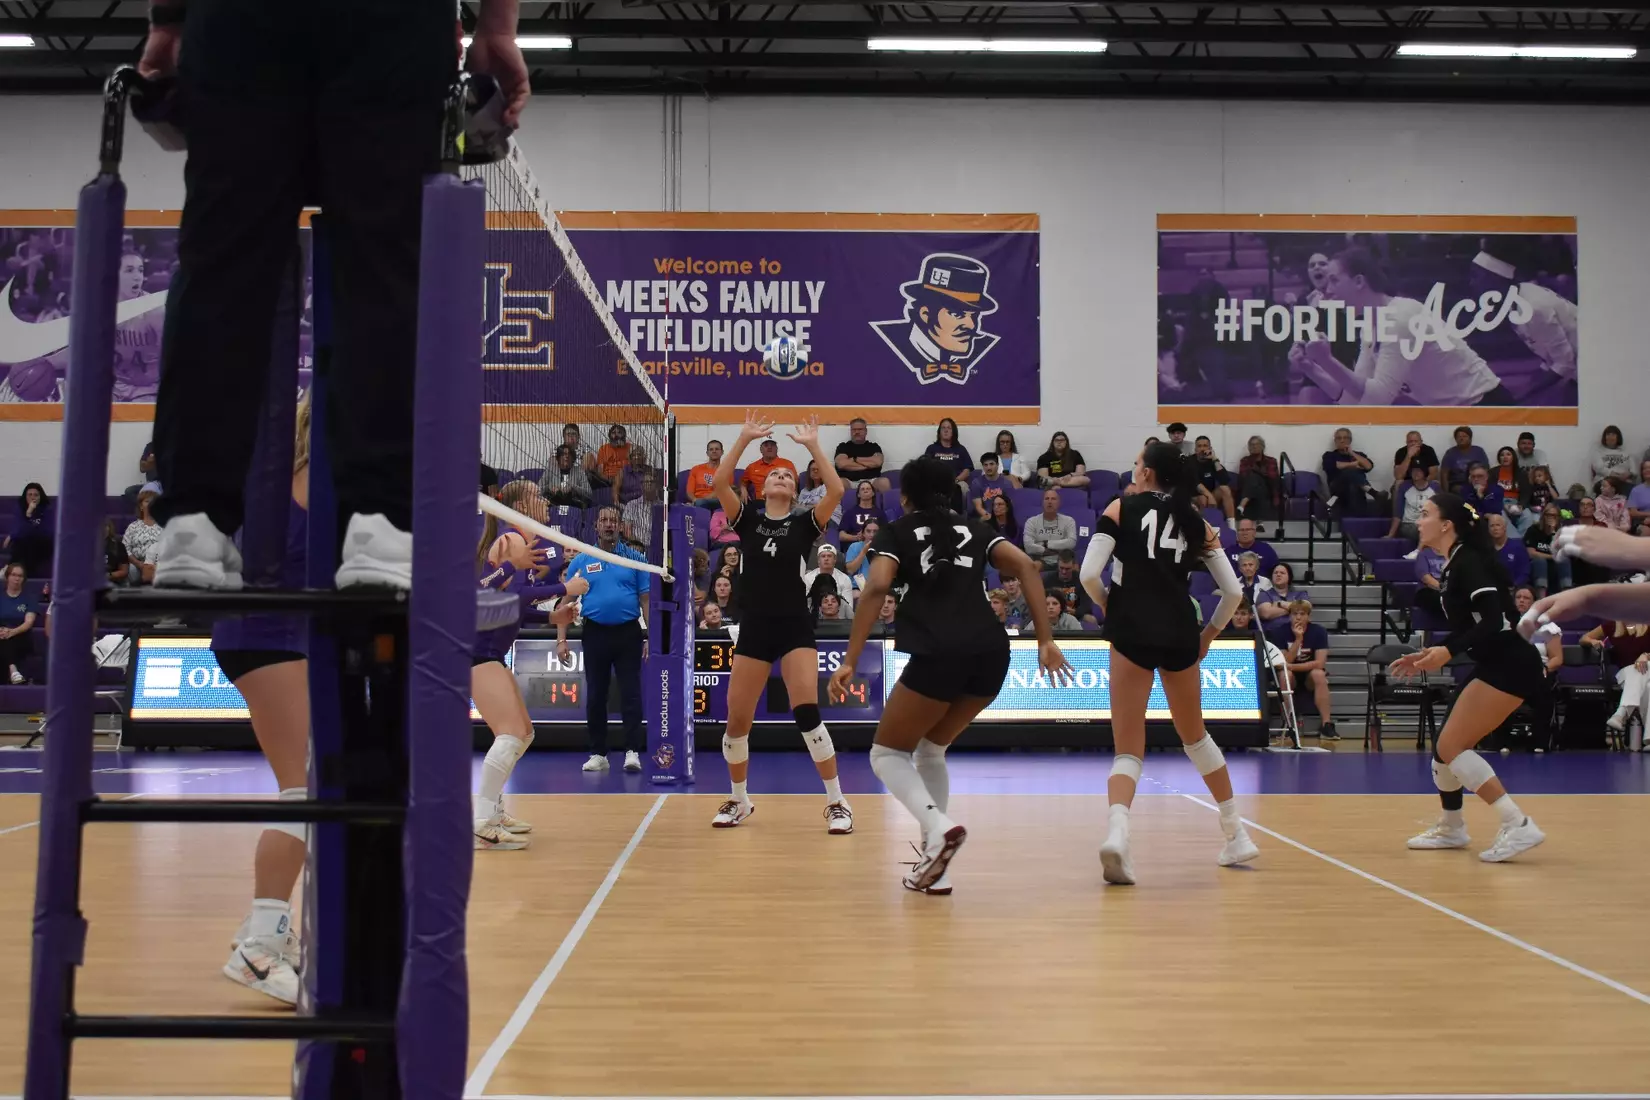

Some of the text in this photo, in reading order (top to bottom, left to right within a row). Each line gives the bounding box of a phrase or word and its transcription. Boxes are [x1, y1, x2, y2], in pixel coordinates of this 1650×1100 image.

[654, 257, 782, 275] Welcome to
[606, 280, 825, 314] MEEKS FAMILY
[629, 319, 812, 352] FIELDHOUSE
[616, 357, 732, 379] Eansville,
[1141, 508, 1188, 564] 14
[763, 538, 777, 557] 4
[547, 651, 584, 672] HO
[188, 667, 235, 688] OL
[694, 675, 719, 686] RIOD
[1200, 668, 1246, 689] NK
[551, 683, 577, 704] 14
[660, 669, 670, 738] sports imports
